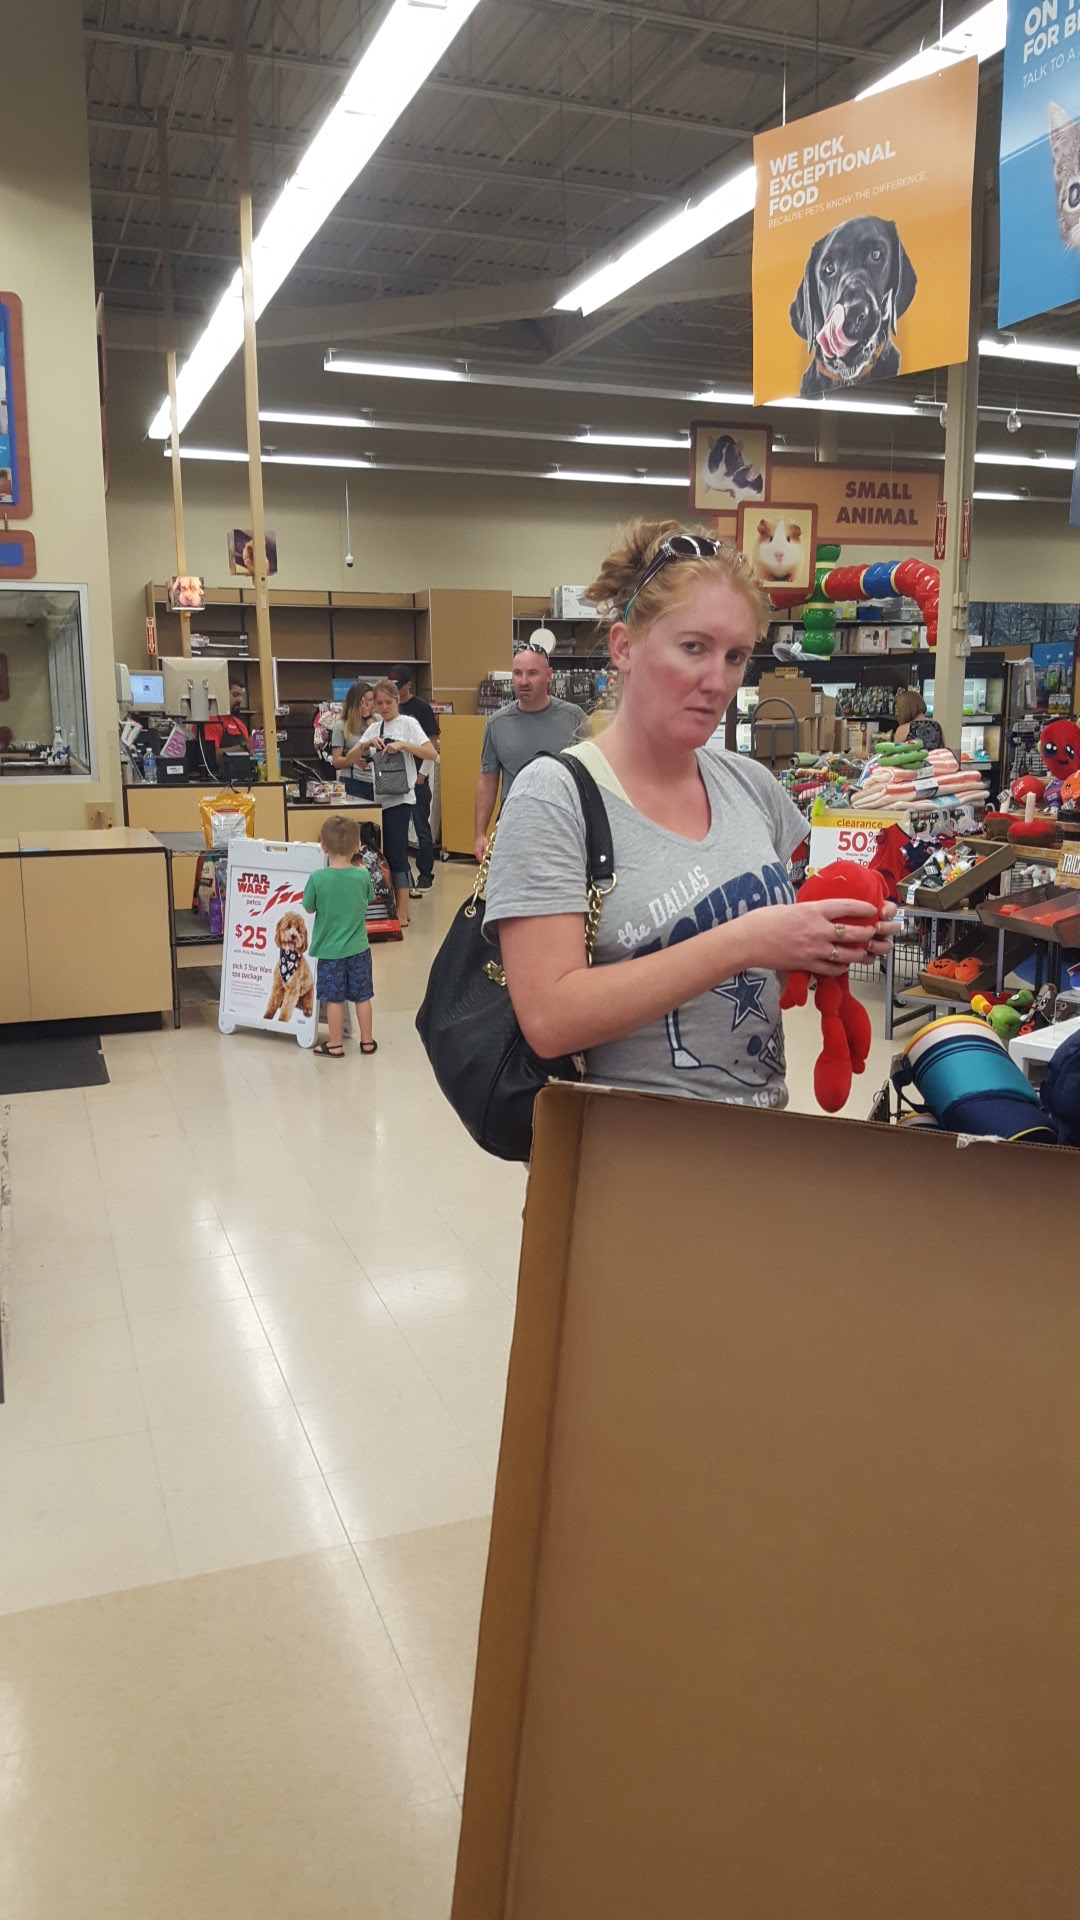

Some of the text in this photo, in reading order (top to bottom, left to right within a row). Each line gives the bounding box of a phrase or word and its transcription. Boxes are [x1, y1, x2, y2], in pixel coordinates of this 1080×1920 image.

[1024, 0, 1058, 36] ON
[1023, 8, 1080, 64] FOR B
[1022, 47, 1076, 88] TALK TO A
[769, 135, 845, 176] WE PICK
[769, 140, 896, 197] EXCEPTIONAL
[768, 170, 929, 228] BECAUSE PETS KNOW THE DIFFERENCE.
[769, 186, 819, 217] FOOD
[845, 481, 913, 500] SMALL
[836, 506, 919, 525] ANIMAL
[836, 818, 883, 829] clearance
[237, 872, 270, 884] STAR
[237, 882, 270, 895] WARS
[617, 865, 710, 951] the DALLAS
[235, 923, 267, 950] $25
[241, 972, 263, 982] package
[260, 966, 273, 974] Wars
